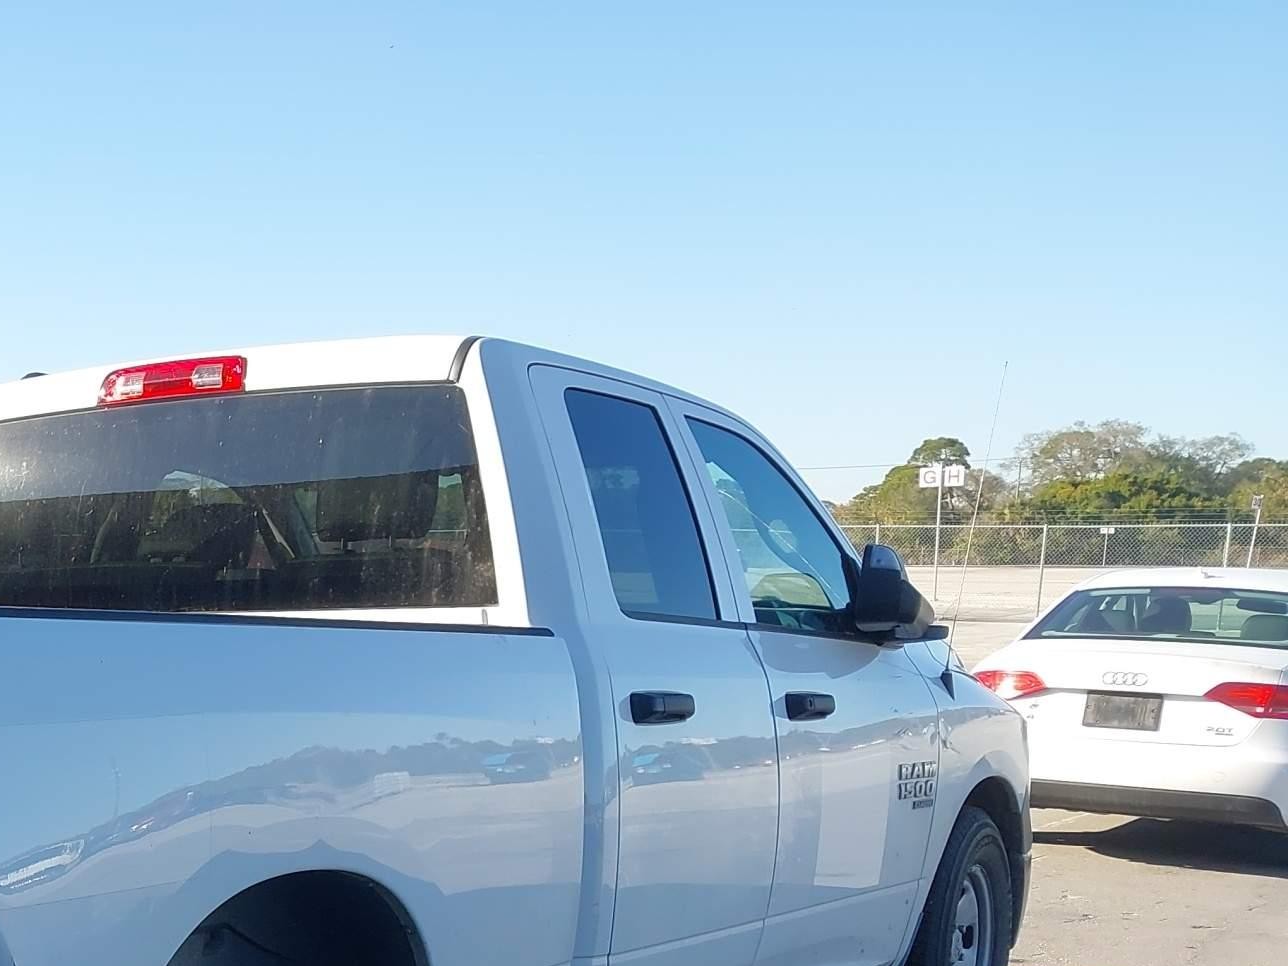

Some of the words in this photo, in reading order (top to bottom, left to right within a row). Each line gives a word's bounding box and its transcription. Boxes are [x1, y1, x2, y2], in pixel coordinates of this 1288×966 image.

[923, 469, 937, 484] G
[947, 468, 961, 484] H
[897, 760, 937, 781] RAM
[897, 780, 935, 801] 1500
